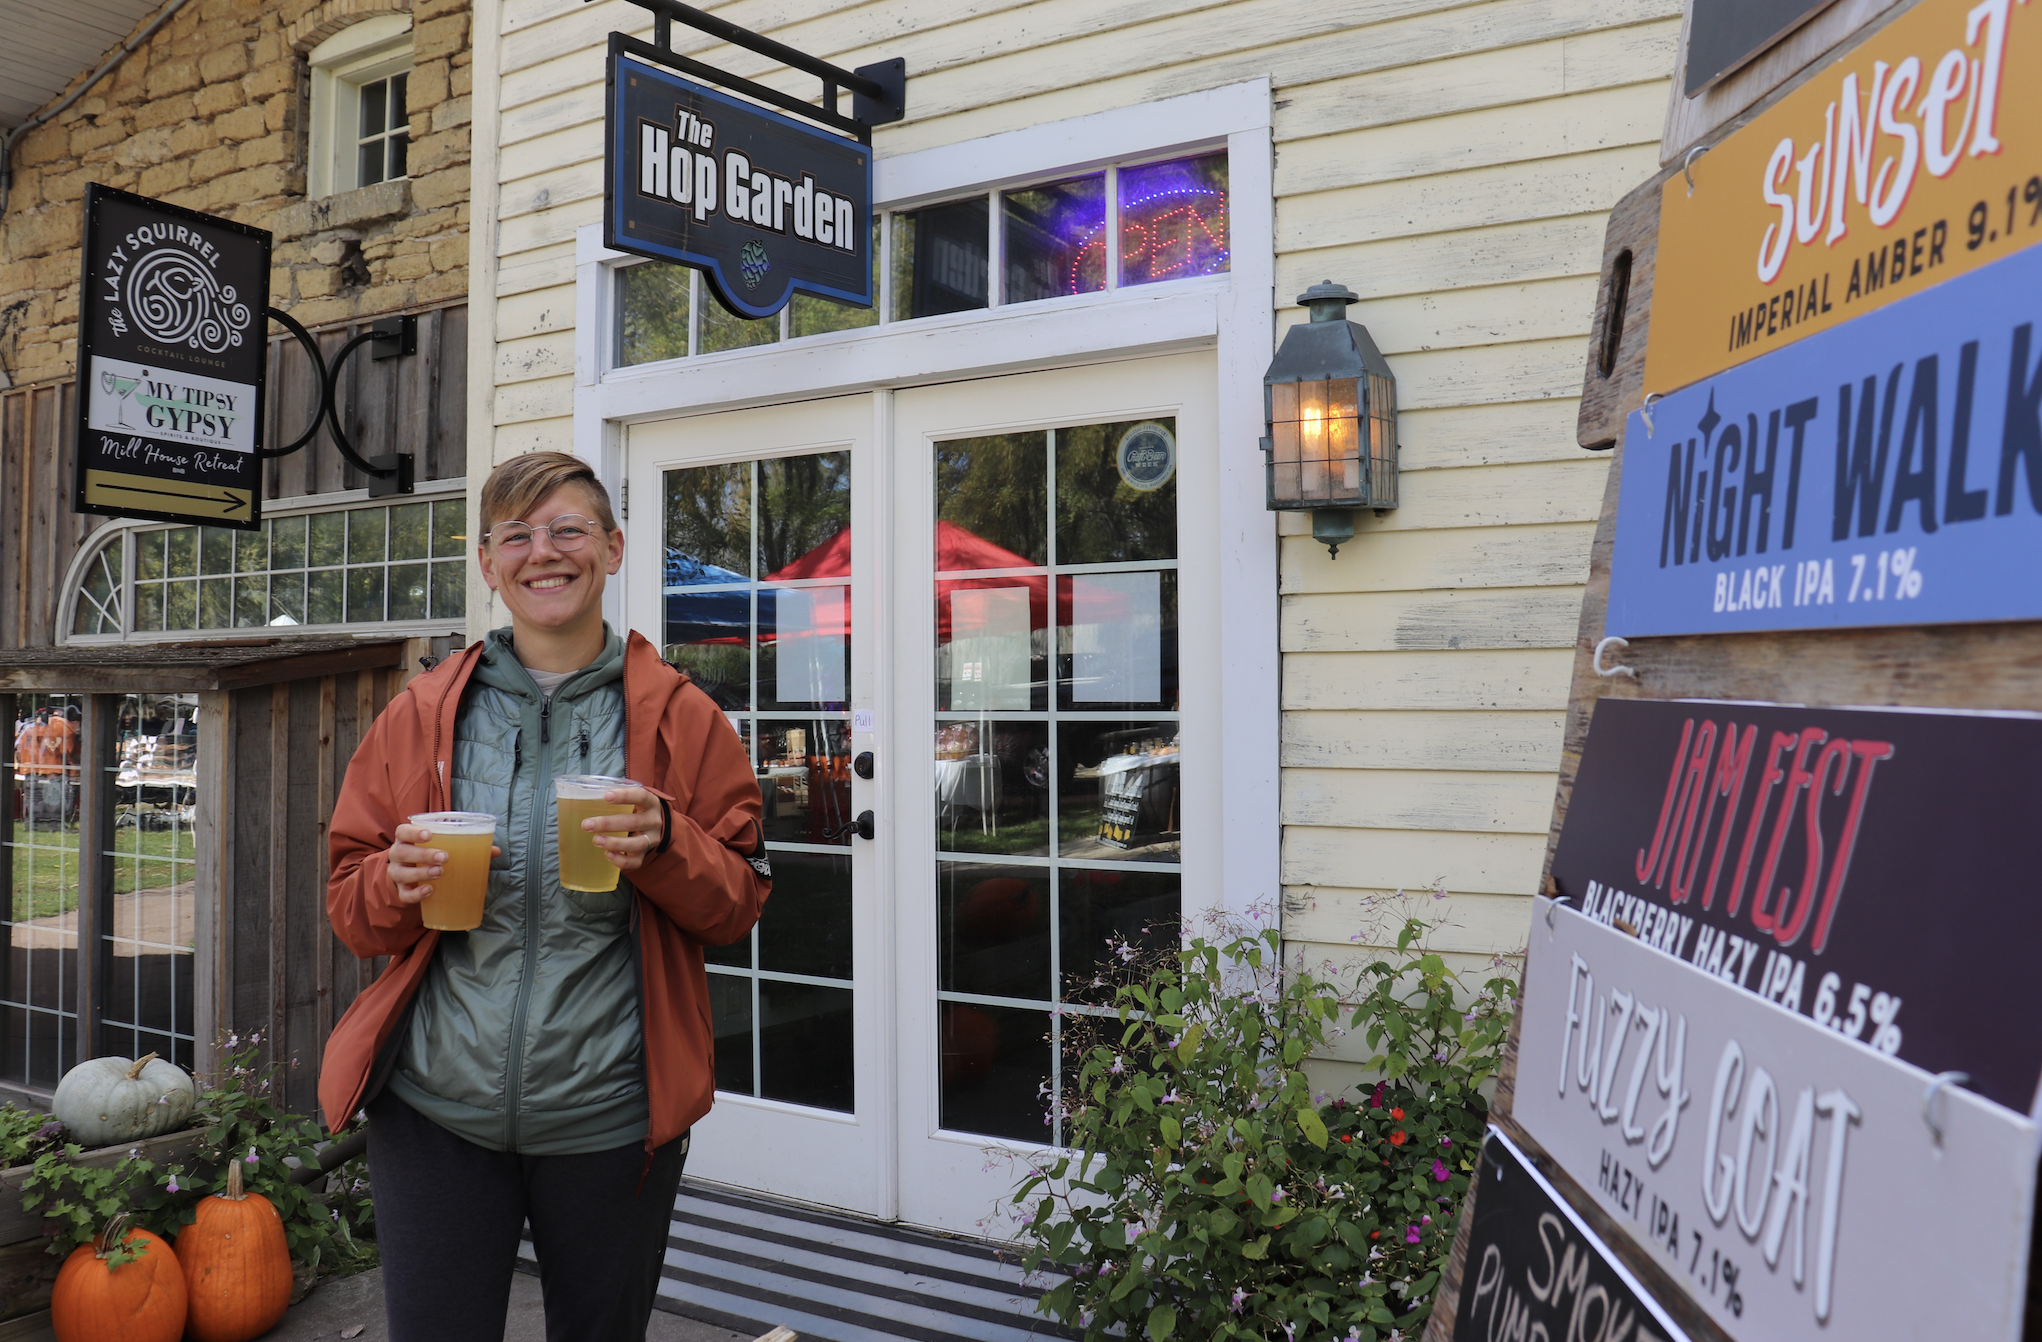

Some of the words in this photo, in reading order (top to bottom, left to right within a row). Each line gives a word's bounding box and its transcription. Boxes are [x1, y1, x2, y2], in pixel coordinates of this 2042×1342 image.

[678, 109, 713, 149] The
[641, 123, 718, 221] Hop
[725, 152, 854, 251] Garden
[104, 245, 128, 302] LAZY
[125, 222, 220, 269] SQUIRREL
[1728, 273, 1832, 352] IMPERIAL
[1845, 219, 1947, 303] AMBER
[108, 307, 128, 338] the
[137, 344, 184, 360] COCKTAIL
[189, 355, 226, 368] LOUNGE
[146, 380, 177, 402] MY
[182, 387, 238, 412] TIPSY
[146, 404, 236, 440] GYPSY
[100, 436, 142, 460] Mill
[144, 444, 189, 465] House
[193, 452, 245, 474] Retreat
[160, 431, 182, 440] SPIRITS
[191, 436, 221, 446] BOUTIQUE
[1832, 322, 2042, 542] WALK
[1713, 565, 1786, 613] BLACK
[1793, 558, 1835, 607] IPA
[1847, 547, 1924, 603] 7.1%
[855, 714, 871, 727] Pull
[1636, 718, 1757, 911] JAM
[1727, 727, 1894, 955] FEST
[1581, 879, 1694, 959] BLACKBERRY
[1692, 923, 1759, 988] HAZY
[1758, 949, 1806, 1011] IPA
[1813, 971, 1902, 1056] 6.5%
[1703, 1039, 1861, 1323] GOAT
[1599, 1148, 1644, 1222] HAZY
[1650, 1194, 1679, 1260] IPA
[1690, 1229, 1743, 1319] 7.1%
[1526, 1211, 1664, 1342] SMOK
